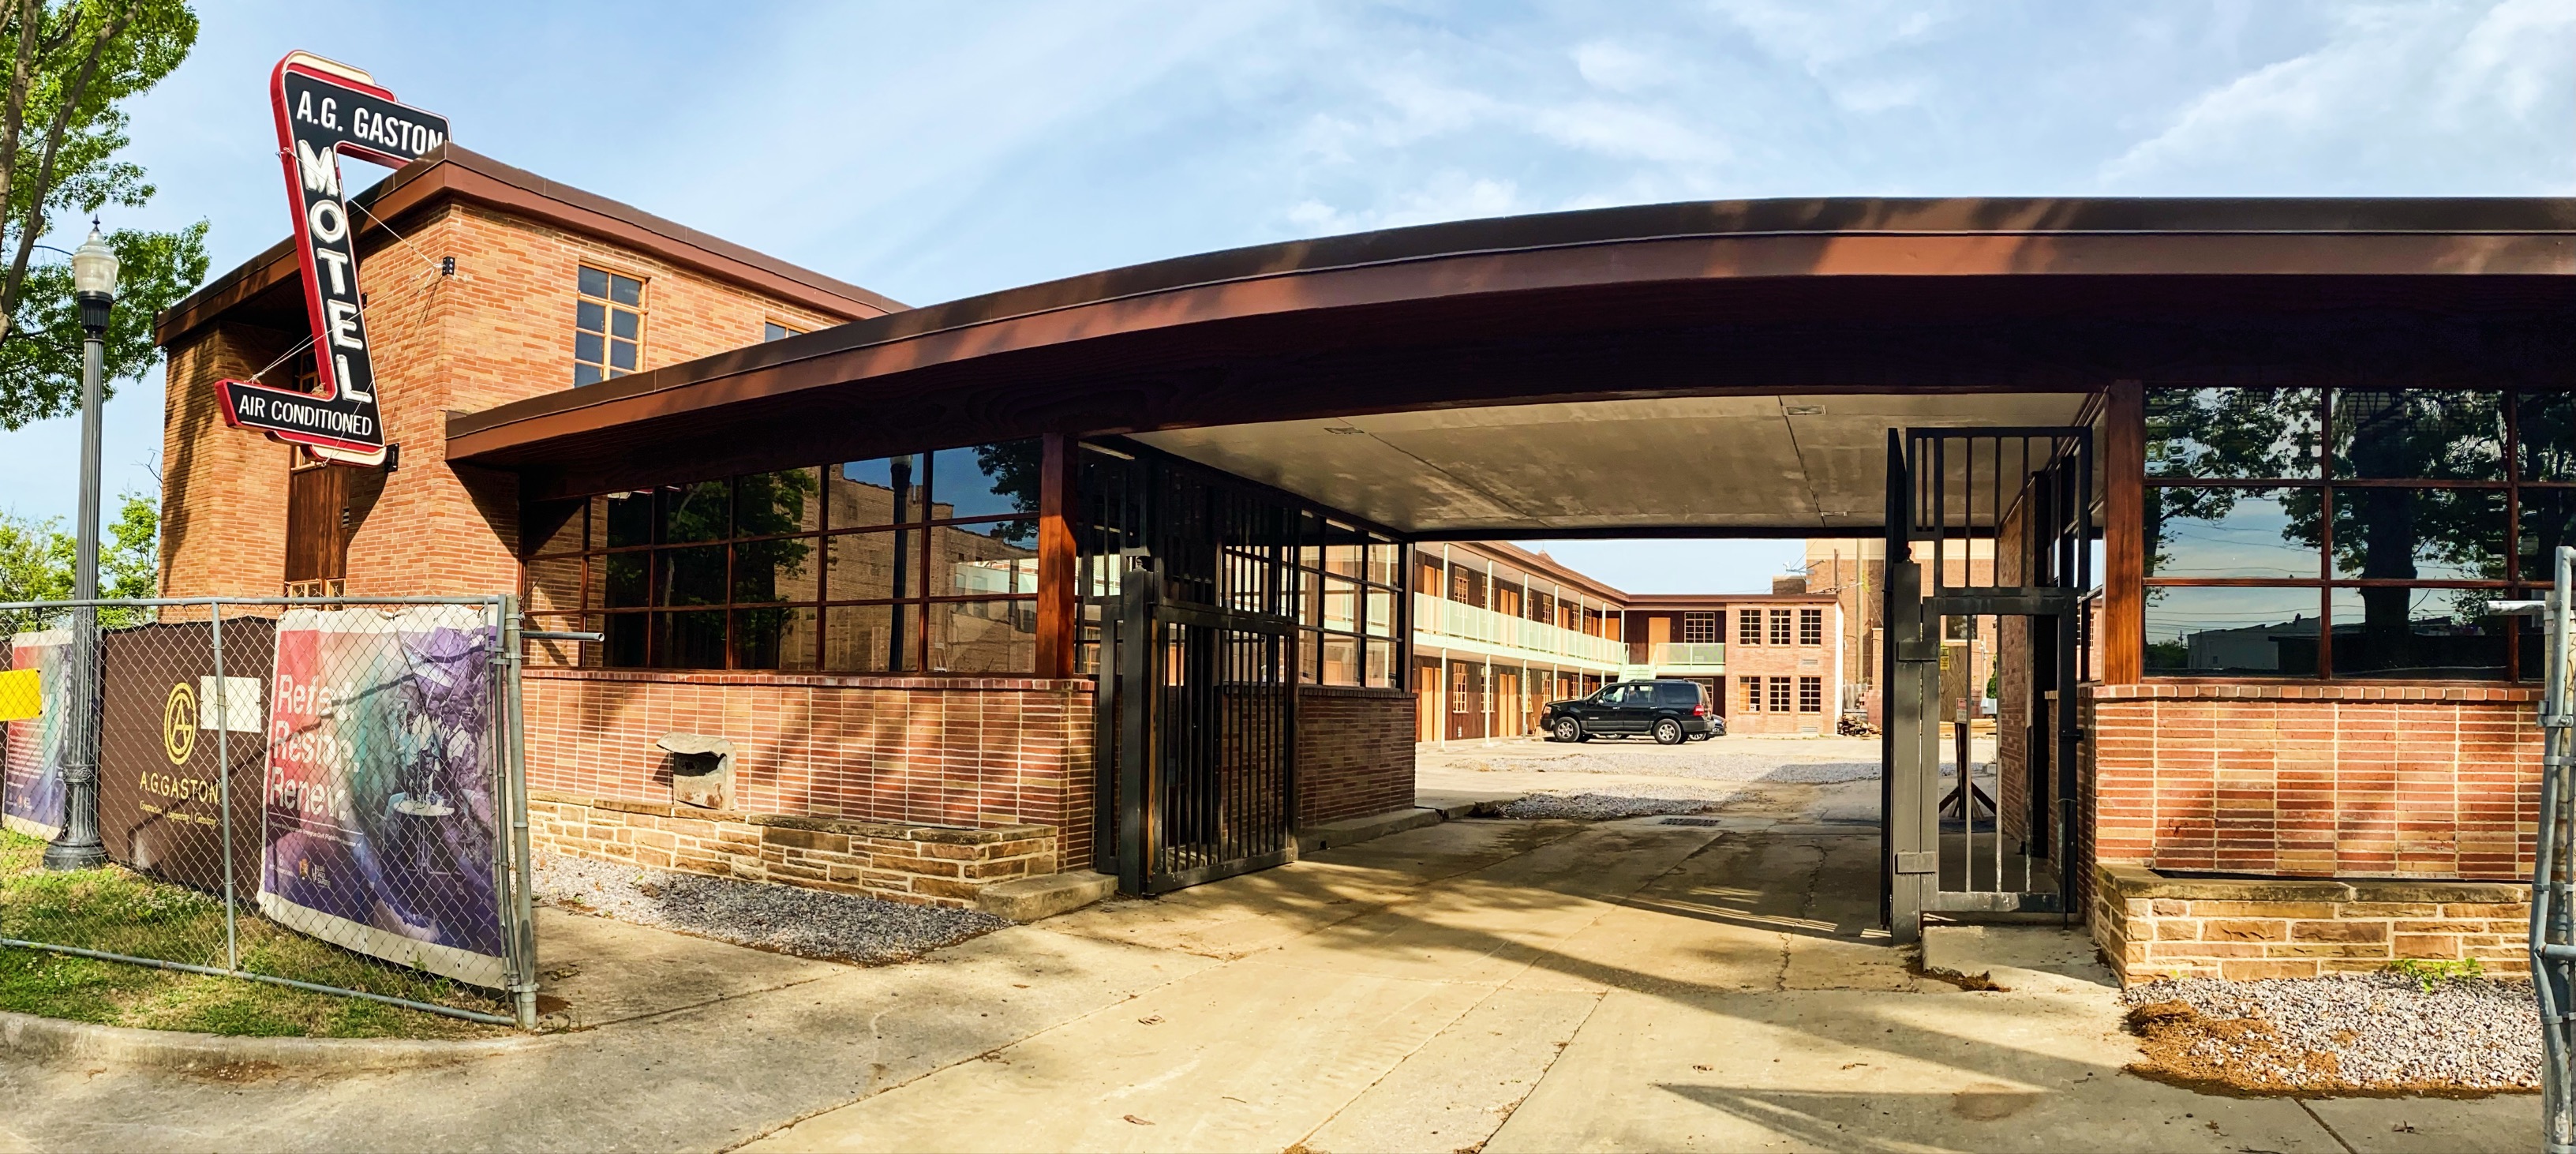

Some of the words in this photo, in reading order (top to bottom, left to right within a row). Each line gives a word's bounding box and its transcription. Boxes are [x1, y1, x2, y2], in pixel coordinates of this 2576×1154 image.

[297, 90, 343, 132] A.G.
[354, 107, 444, 155] GASTON
[297, 139, 373, 404] MOTEL
[238, 395, 266, 418] AIR
[271, 400, 373, 436] CONDITIONED
[278, 674, 354, 721] Reflet.
